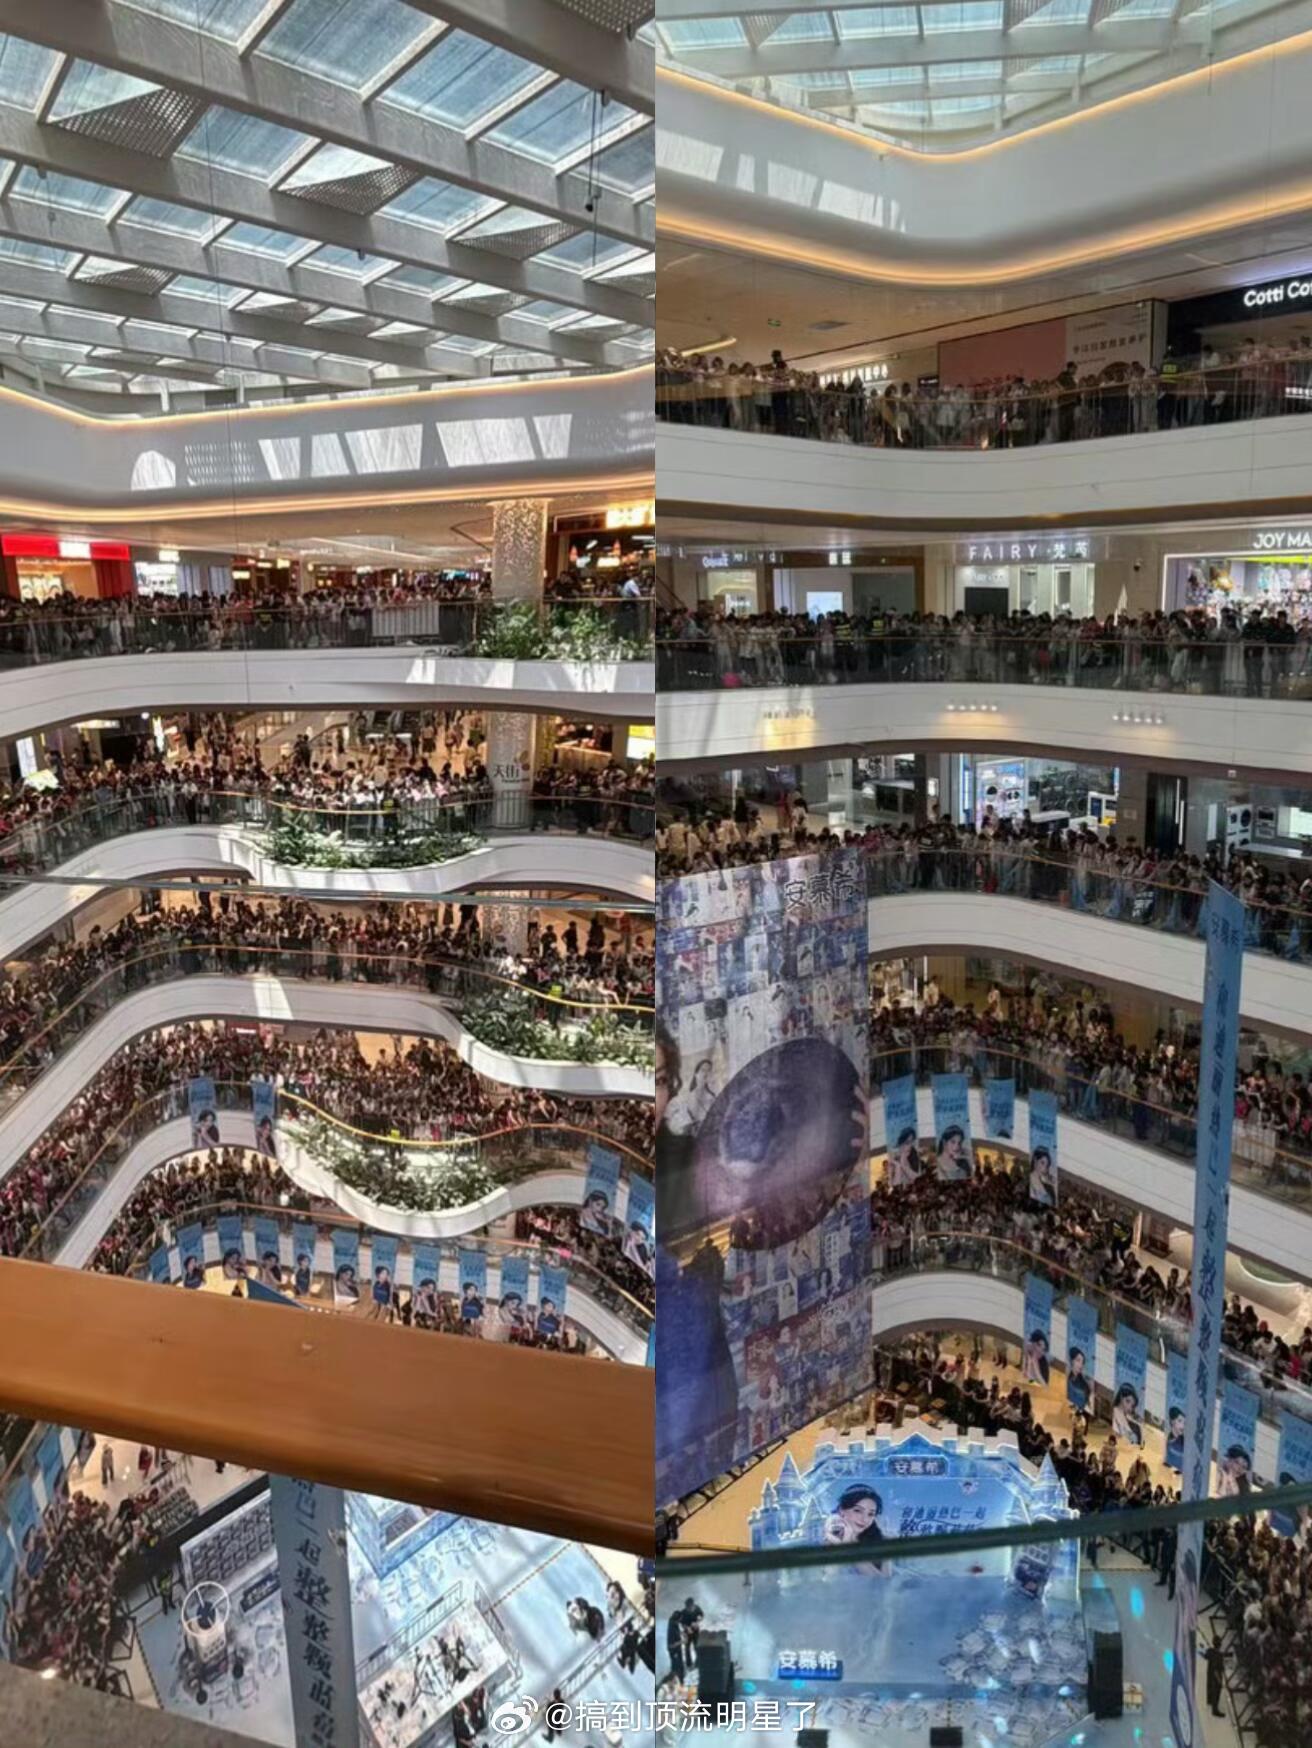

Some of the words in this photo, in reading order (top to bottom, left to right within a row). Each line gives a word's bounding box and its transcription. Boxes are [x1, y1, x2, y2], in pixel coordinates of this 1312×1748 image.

[1243, 284, 1284, 307] Cotti
[1287, 281, 1312, 299] Co
[1253, 532, 1286, 550] JOY
[968, 543, 1038, 561] FAIRY
[778, 1649, 838, 1671] 安慕希
